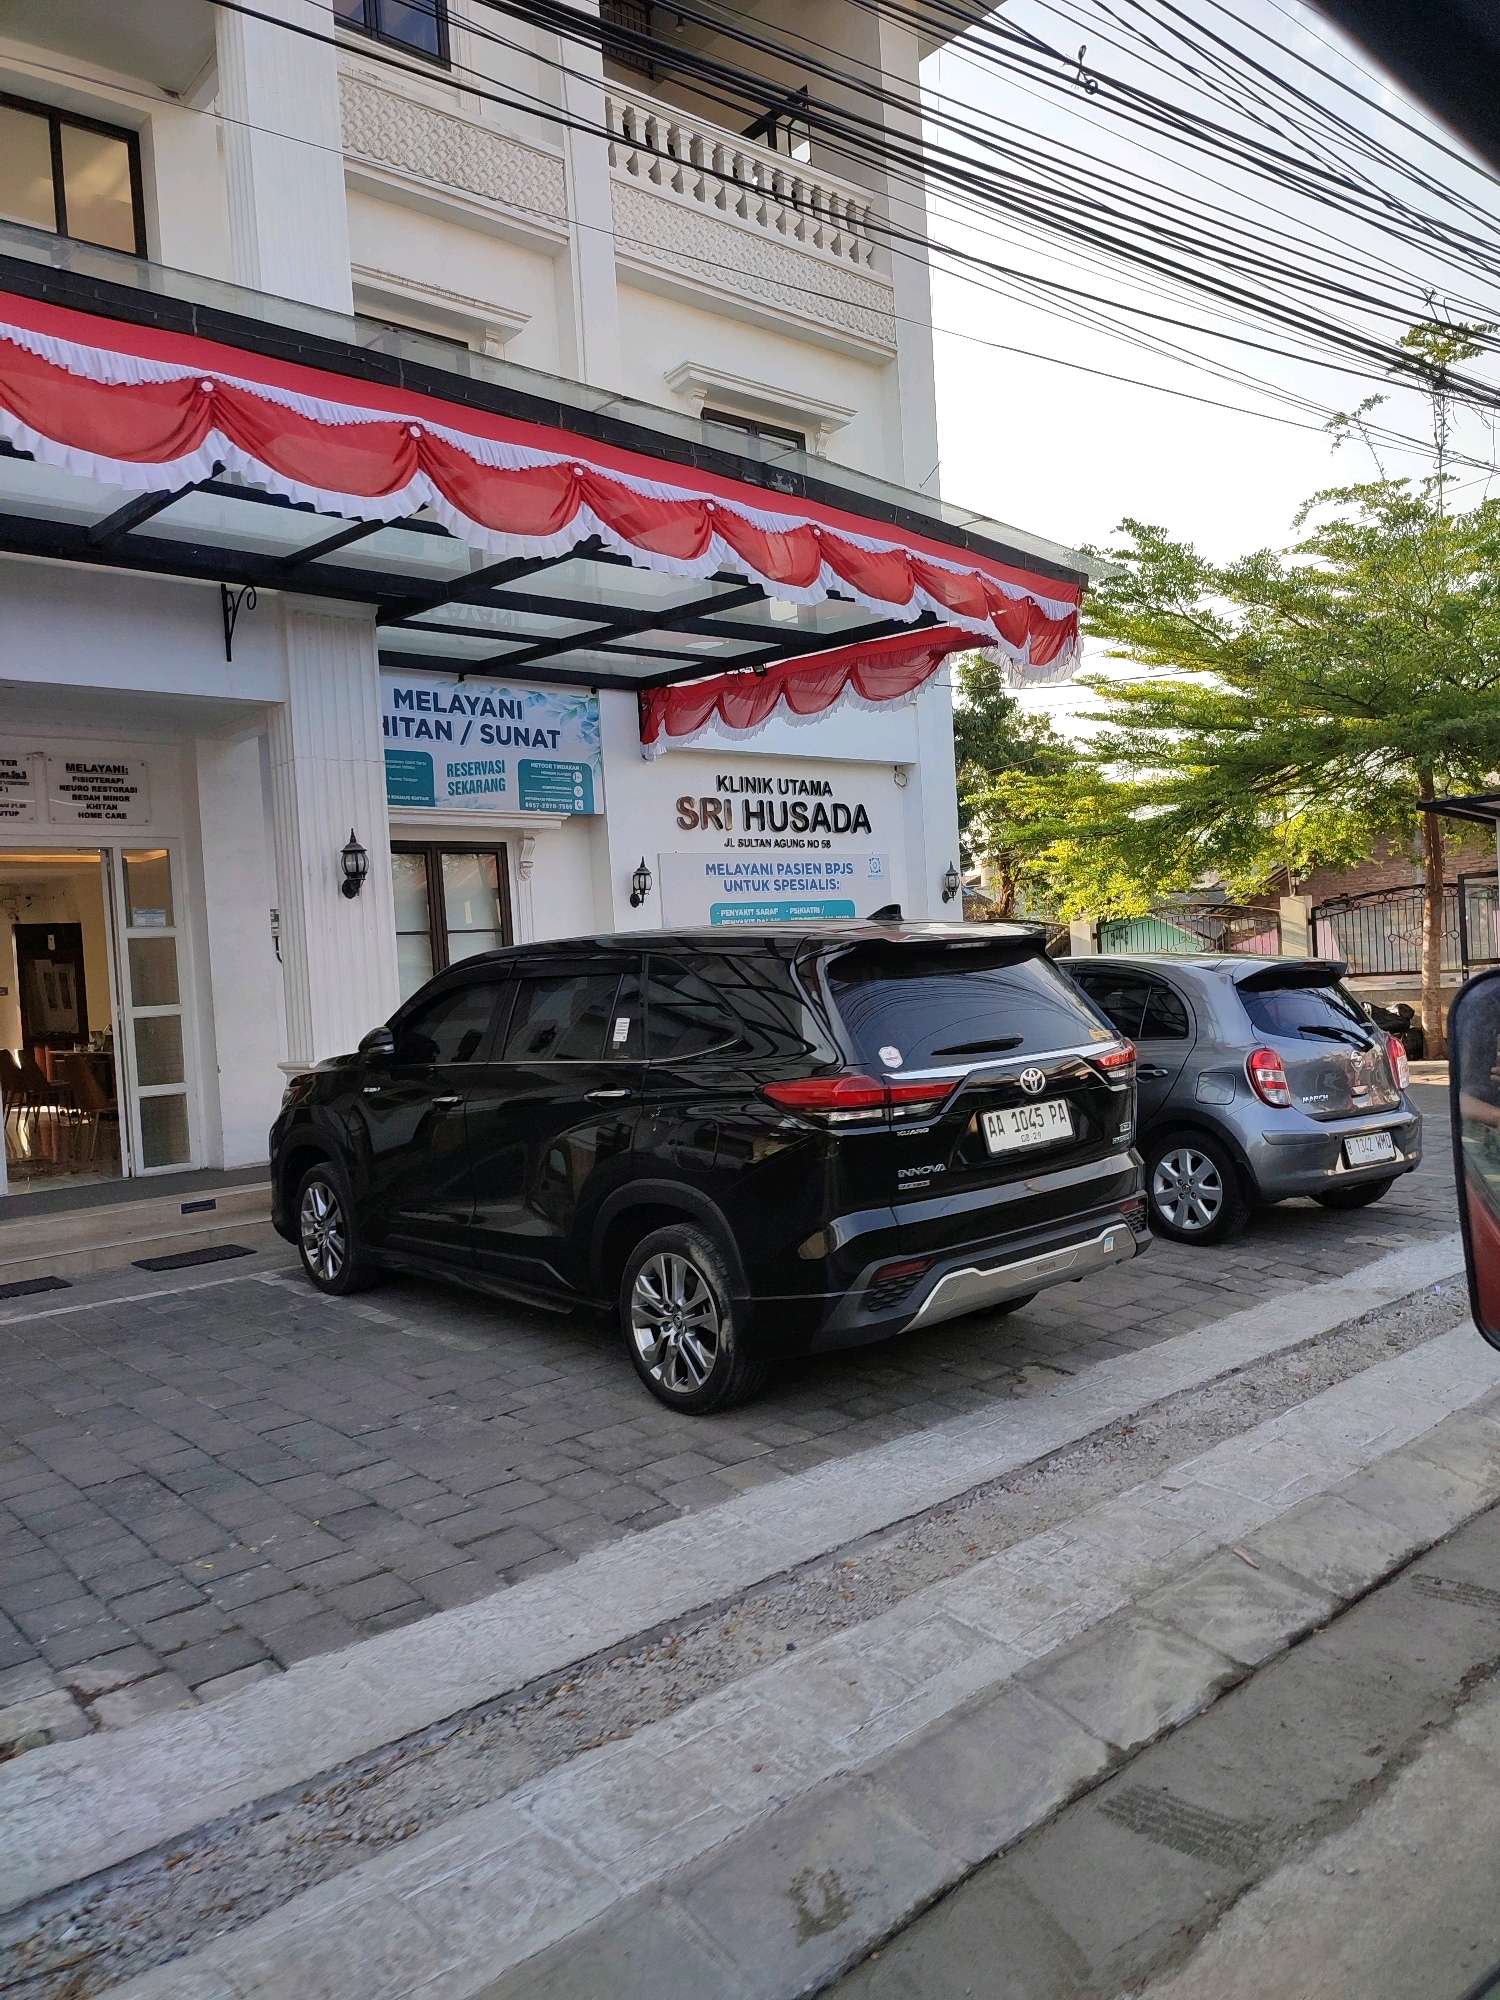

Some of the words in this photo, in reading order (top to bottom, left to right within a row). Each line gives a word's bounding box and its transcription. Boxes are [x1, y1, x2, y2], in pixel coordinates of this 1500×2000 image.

[393, 687, 523, 720] MELAYANI
[480, 723, 561, 749] SUNAT
[65, 762, 129, 774] MELAYANI:
[446, 760, 506, 778] RESERVASI
[72, 776, 124, 784] FISIOTERAPI
[447, 777, 506, 796] SEKARANG
[716, 774, 773, 794] KLINIK
[778, 779, 833, 797] UTAMA
[59, 784, 90, 792] NEURO
[105, 812, 127, 820] CARE
[676, 796, 734, 831] SRI
[743, 798, 872, 834] HUSADA
[737, 838, 772, 848] SULTAN
[774, 839, 806, 848] AGUNG
[807, 840, 820, 849] NO
[705, 863, 773, 876] MELAYANI
[777, 863, 822, 876] PASIEN
[825, 863, 854, 875] BPJS
[724, 878, 770, 892] UNTUK
[774, 878, 841, 892] SPESIALIS:
[721, 908, 754, 916] PENYAKIT
[756, 908, 778, 916] SARAF
[1302, 1094, 1328, 1104] MARCH
[988, 1115, 1006, 1138] AA
[1011, 1107, 1044, 1133] 1045
[1049, 1102, 1067, 1125] PA
[1346, 1140, 1353, 1156] B
[1356, 1138, 1374, 1154] 1342
[898, 1164, 946, 1178] INNOVA
